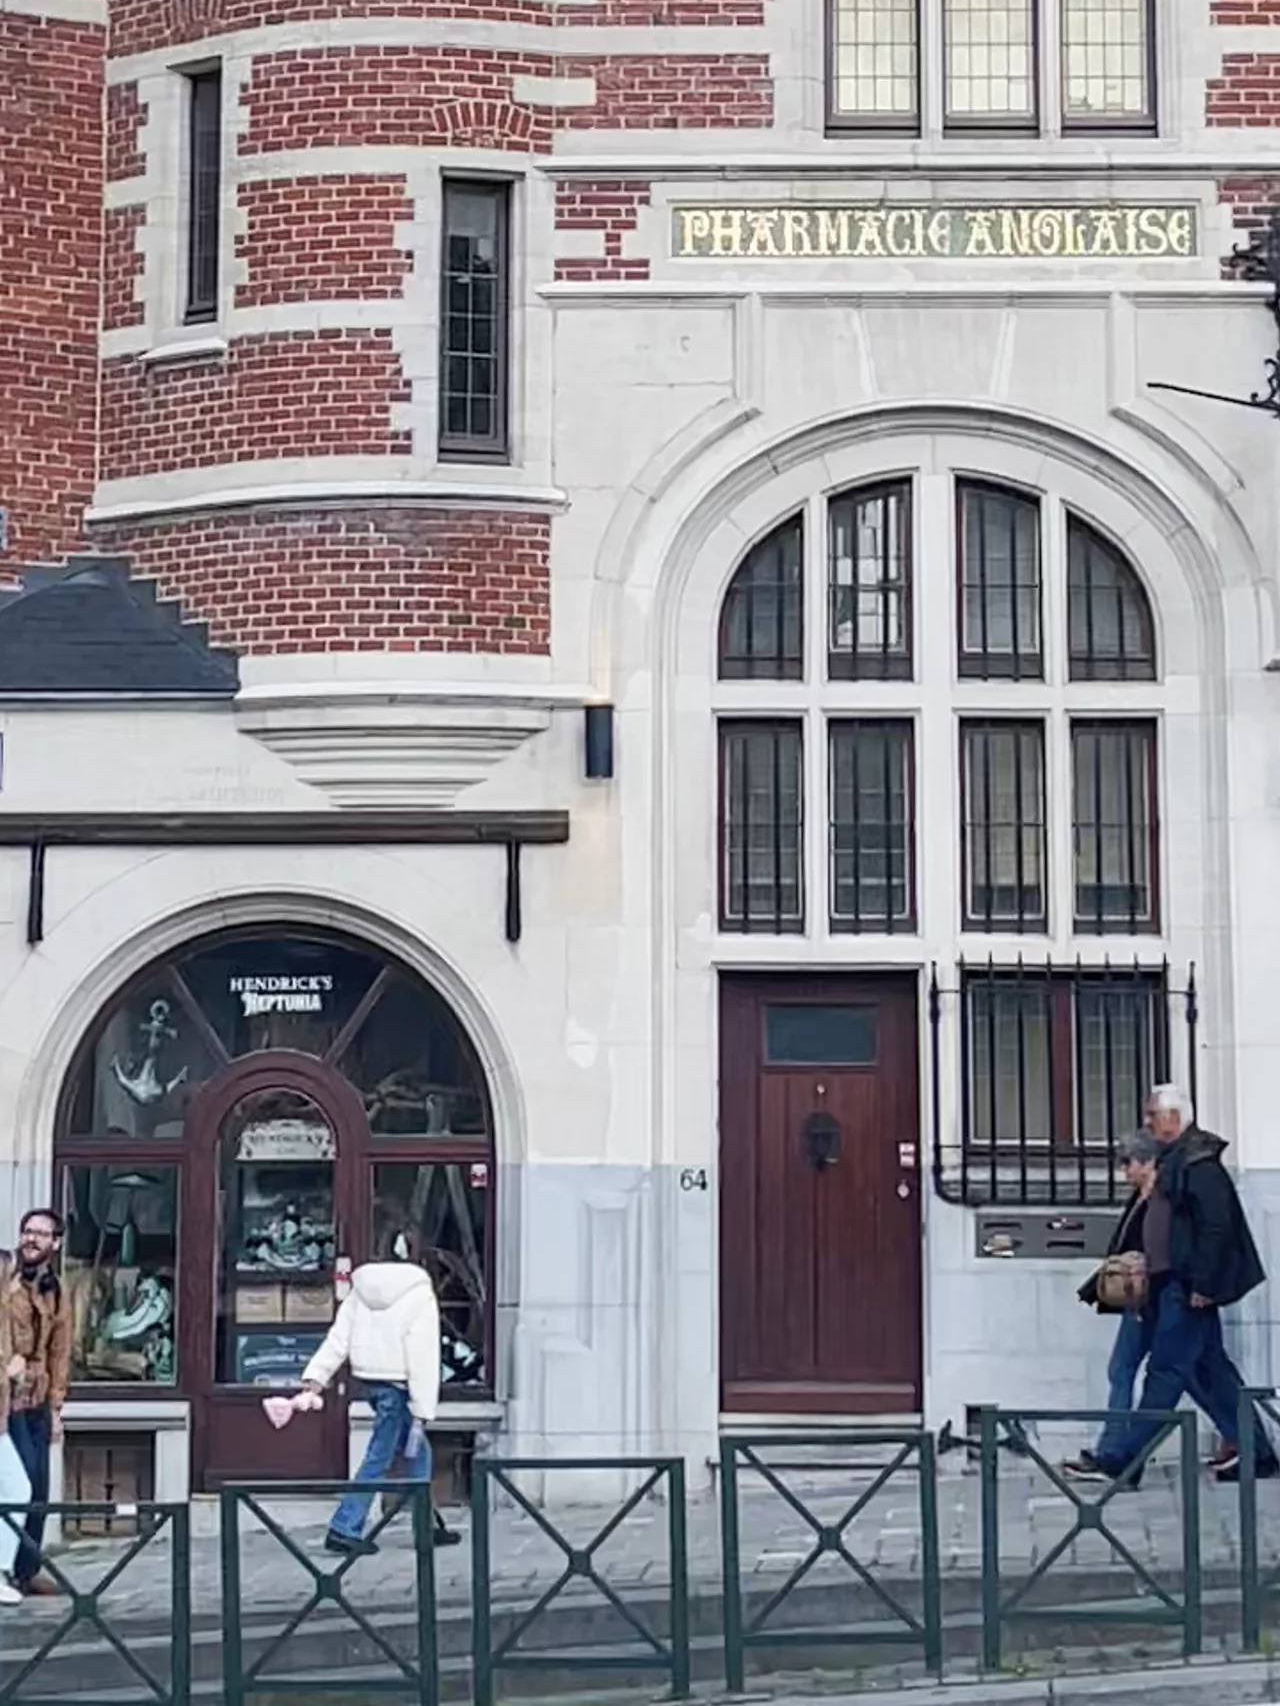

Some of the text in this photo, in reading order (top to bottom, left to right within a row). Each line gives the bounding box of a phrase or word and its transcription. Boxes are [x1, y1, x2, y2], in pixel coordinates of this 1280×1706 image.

[678, 209, 1191, 256] PHARMACIE ANGLAISE
[680, 1169, 707, 1191] 64
